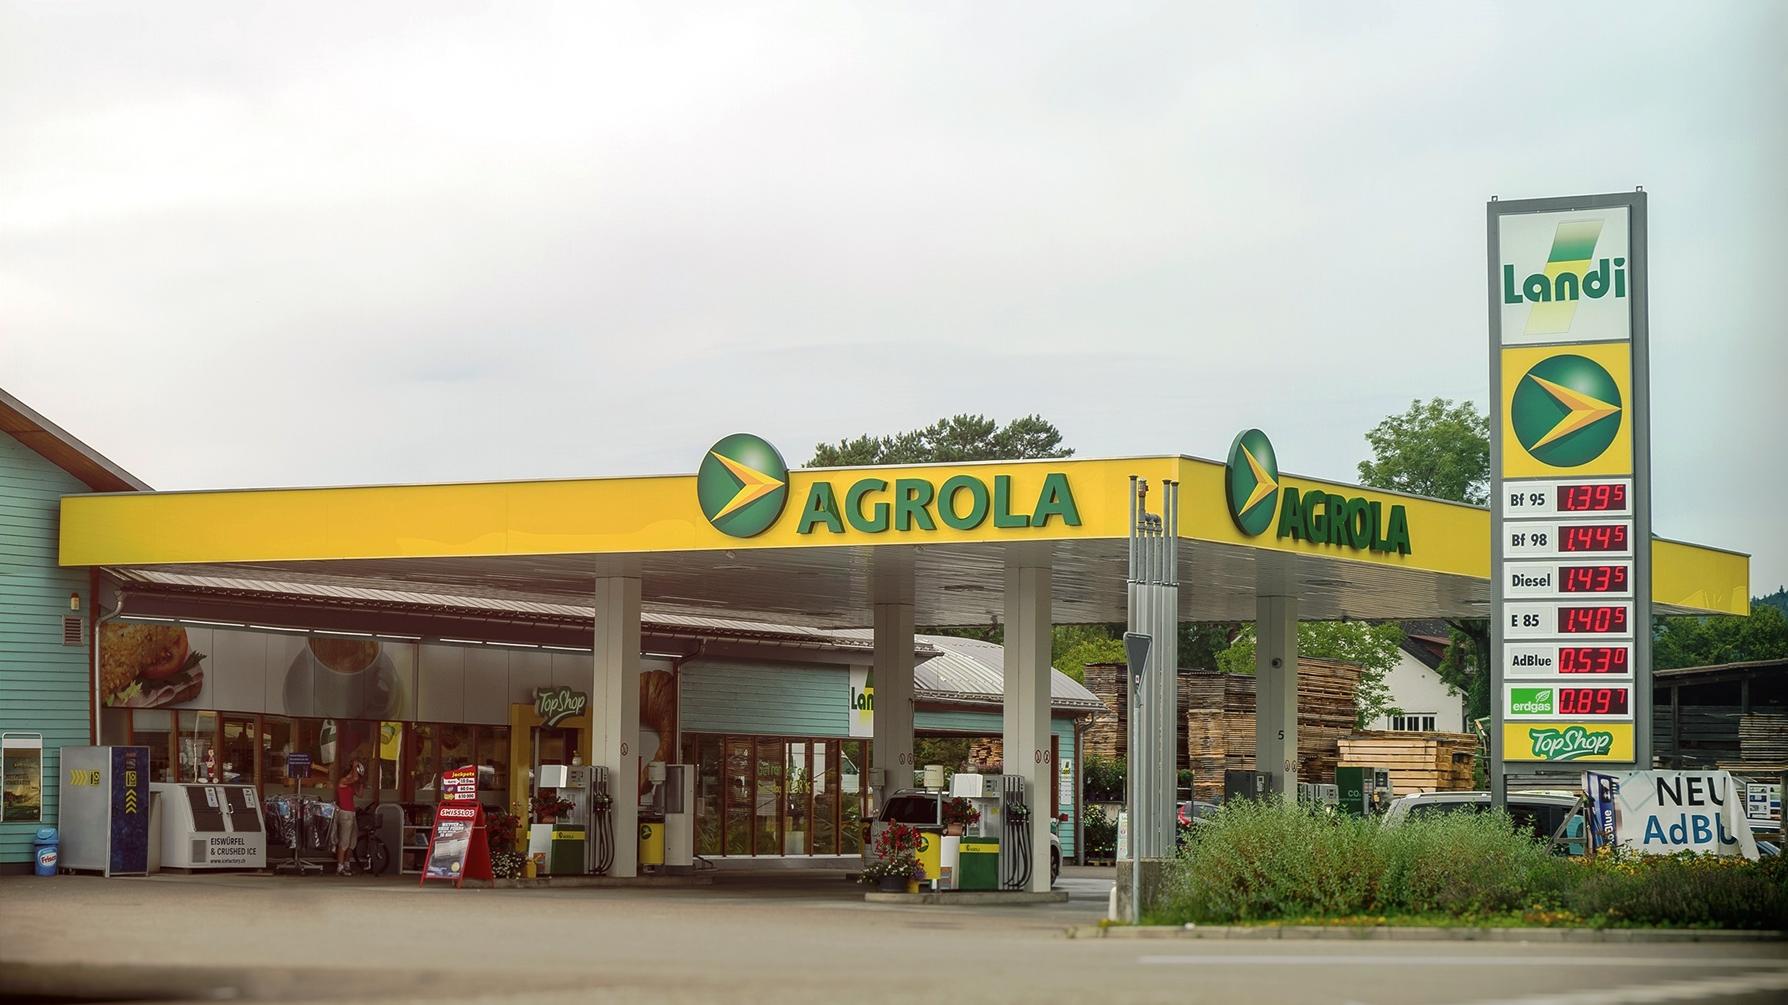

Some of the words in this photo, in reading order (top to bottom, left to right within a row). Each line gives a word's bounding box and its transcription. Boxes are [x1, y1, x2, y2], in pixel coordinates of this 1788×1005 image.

[1504, 257, 1626, 304] Landi
[796, 473, 1083, 534] AGROLA
[1510, 493, 1525, 507] Bf
[1530, 492, 1545, 506] 95
[1276, 487, 1412, 556] AGROLA
[1511, 533, 1526, 547] Bf
[1531, 533, 1547, 547] 98
[1512, 573, 1551, 587] Diesel
[1511, 614, 1518, 627] E
[1523, 614, 1539, 627] 85
[1512, 654, 1552, 667] AdBlue
[538, 690, 586, 718] TopShop
[1512, 700, 1551, 713] erdgas
[1278, 730, 1285, 740] 5
[1533, 728, 1611, 759] TopShop
[1656, 776, 1727, 807] NEU
[210, 836, 245, 846] EISWÜRFEL
[210, 848, 216, 856] &
[217, 848, 246, 856] CRUSHED
[247, 848, 257, 856] ICE
